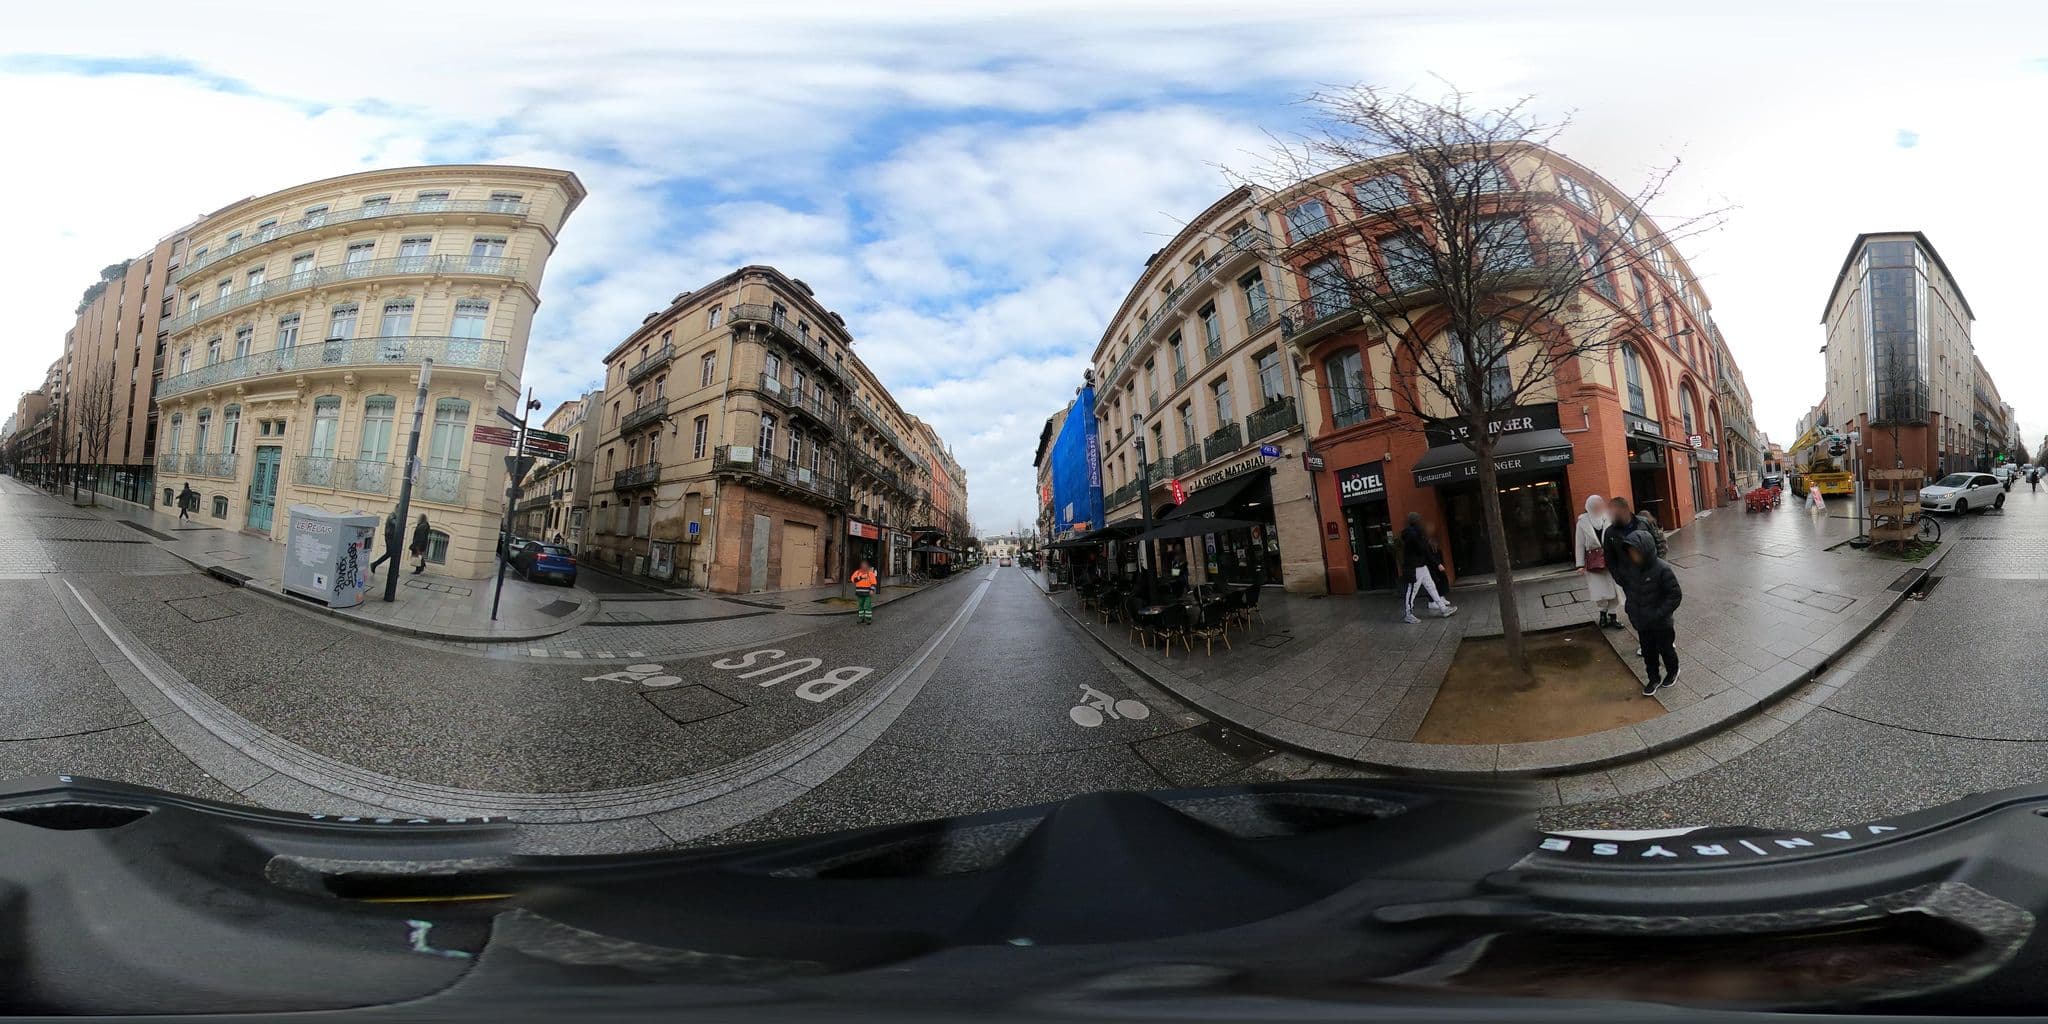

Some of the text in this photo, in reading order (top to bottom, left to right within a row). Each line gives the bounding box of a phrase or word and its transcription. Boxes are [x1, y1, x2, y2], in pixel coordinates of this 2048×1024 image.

[1194, 456, 1266, 489] LA CHOPE MATABIAU
[1464, 465, 1478, 476] LE
[1417, 471, 1452, 483] Restaurant
[296, 521, 304, 530] LE
[711, 649, 875, 703] BUS
